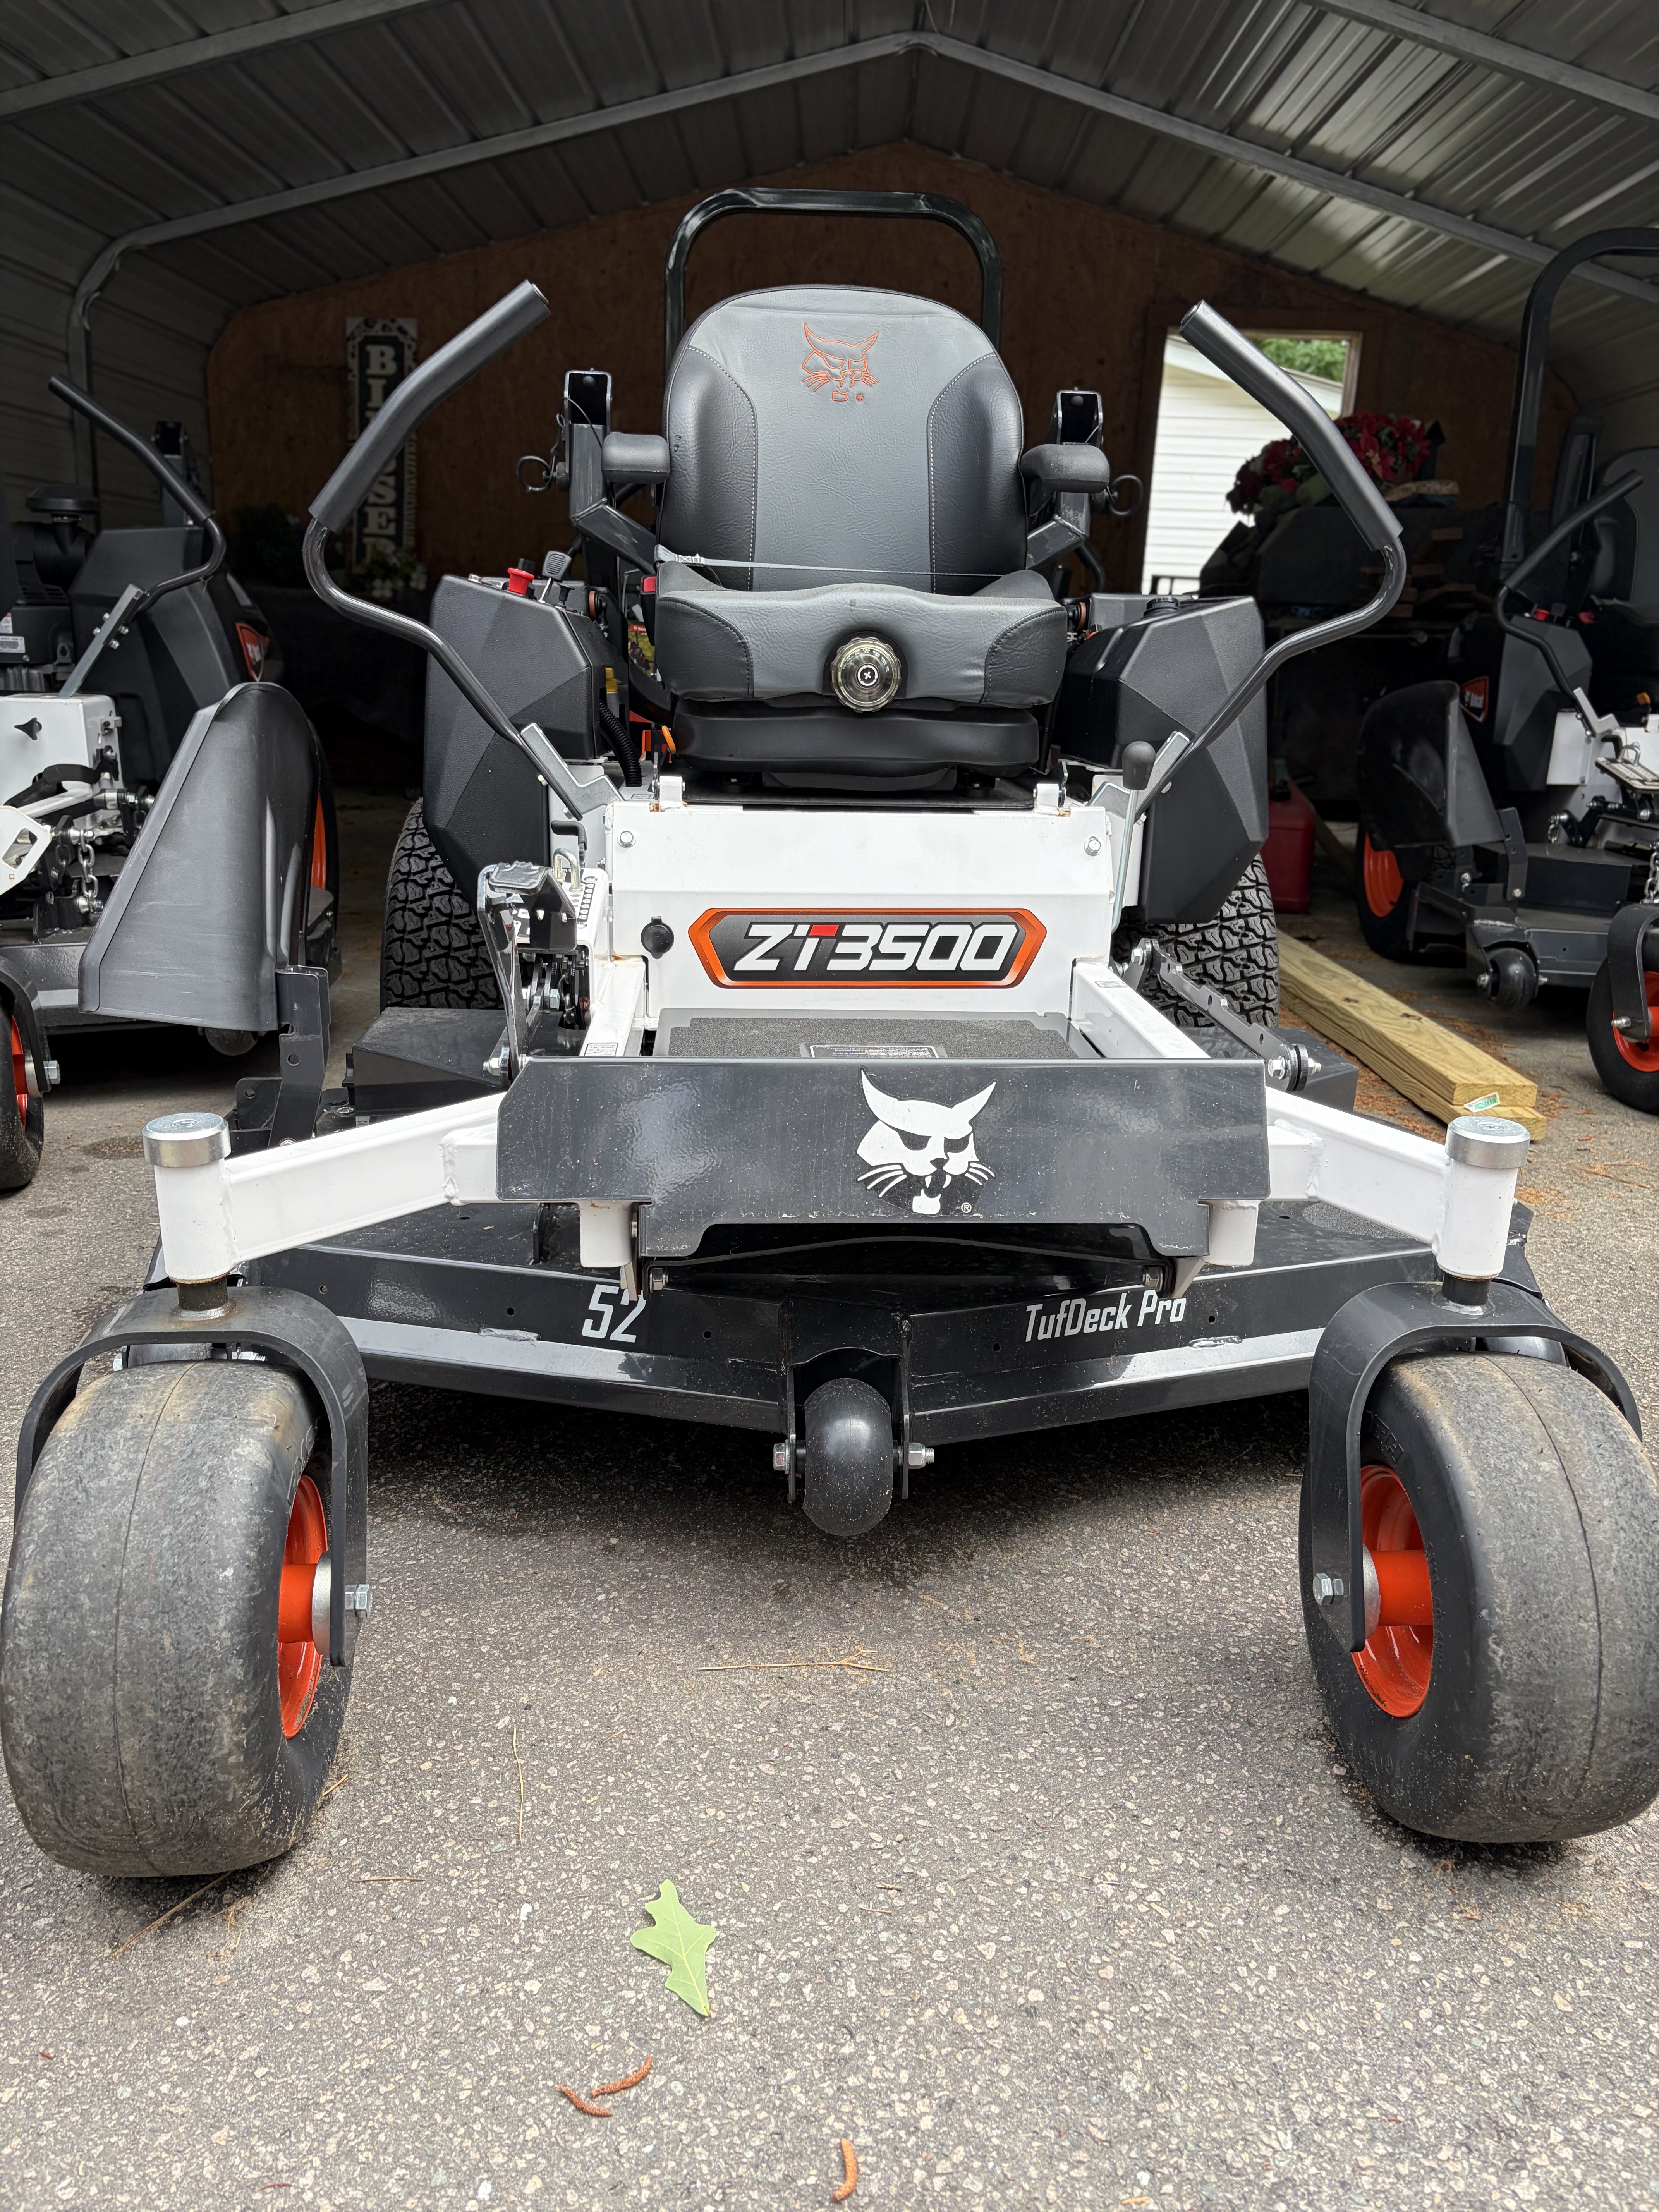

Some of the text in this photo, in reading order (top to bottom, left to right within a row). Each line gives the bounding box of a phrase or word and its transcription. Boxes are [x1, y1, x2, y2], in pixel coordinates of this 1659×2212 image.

[733, 924, 1018, 971] ZT3500
[581, 1284, 647, 1343] 52
[1025, 1289, 1187, 1342] TufDeck Pro
